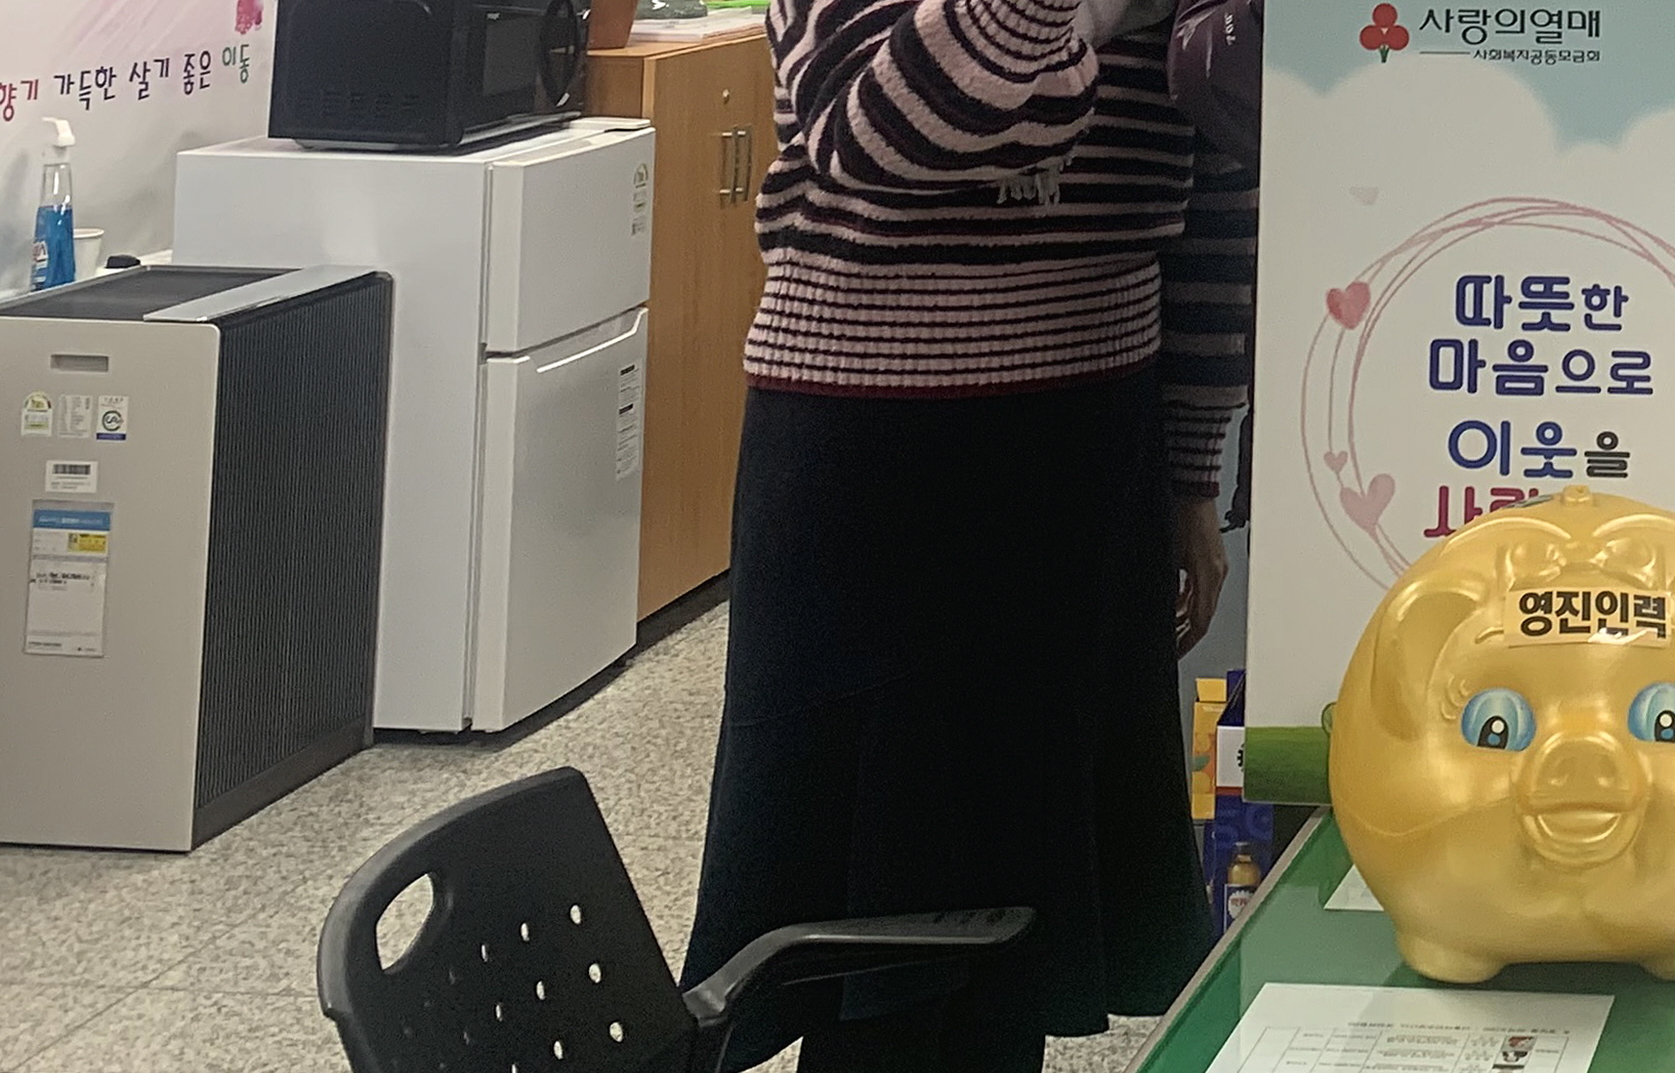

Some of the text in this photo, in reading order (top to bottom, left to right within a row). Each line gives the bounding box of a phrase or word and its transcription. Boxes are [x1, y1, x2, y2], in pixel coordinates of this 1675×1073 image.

[1419, 8, 1601, 46] 사랑의열매
[0, 43, 250, 122] 향기 가득한 살기 좋은 이동
[1472, 48, 1601, 66] 사회복지공동모금회
[1455, 274, 1630, 333] 따뜻한
[1428, 338, 1655, 397] 마음으로
[1446, 419, 1632, 480] 이웃을
[1518, 590, 1668, 639] 영진인력
